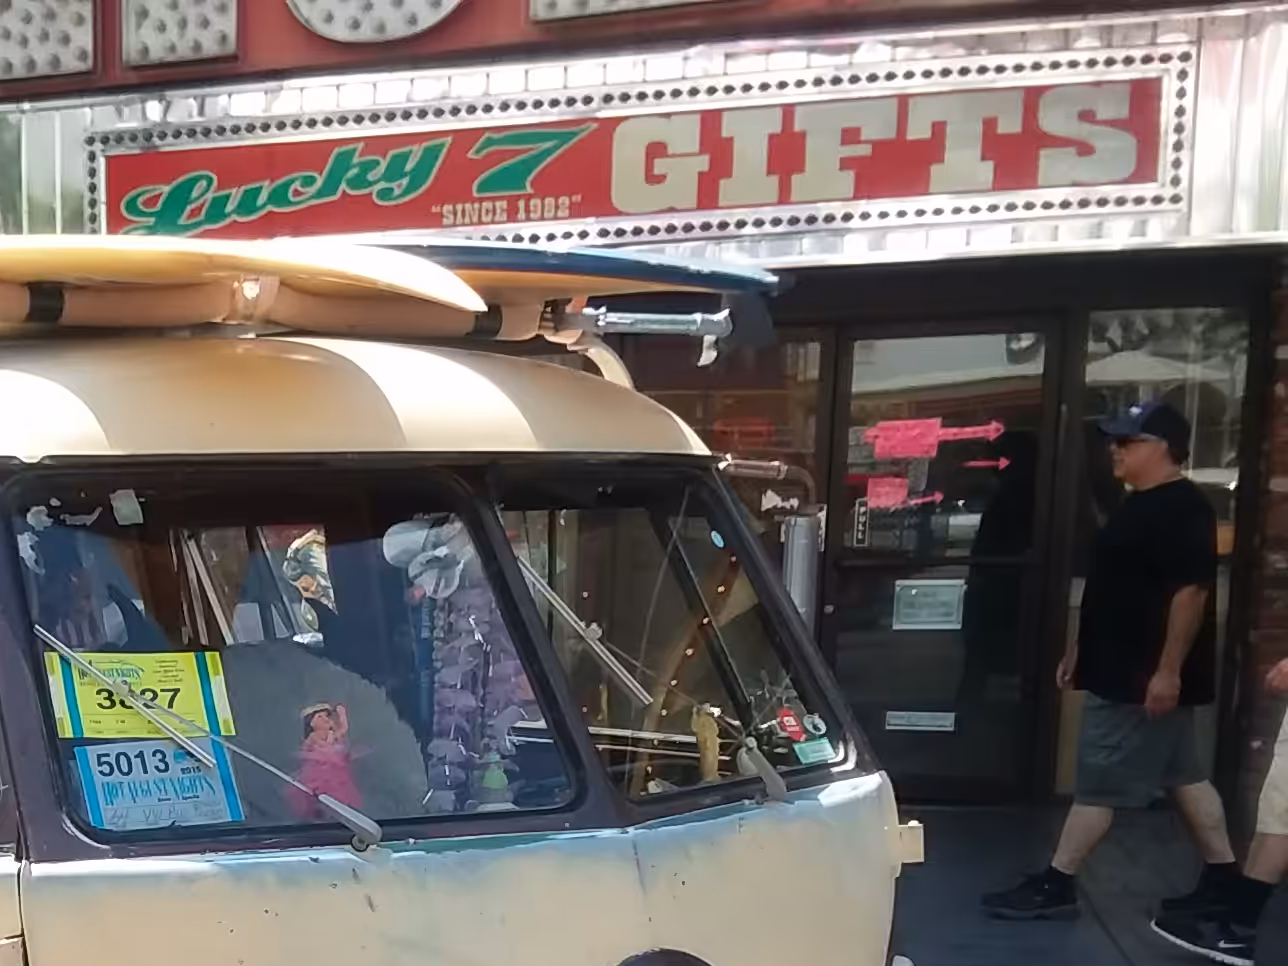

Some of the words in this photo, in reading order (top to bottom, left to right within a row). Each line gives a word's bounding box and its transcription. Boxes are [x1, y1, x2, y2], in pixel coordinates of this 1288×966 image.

[118, 136, 453, 236] Lucky
[467, 121, 600, 198] 7
[609, 79, 1141, 214] GIFTS
[96, 749, 170, 777] 5013
